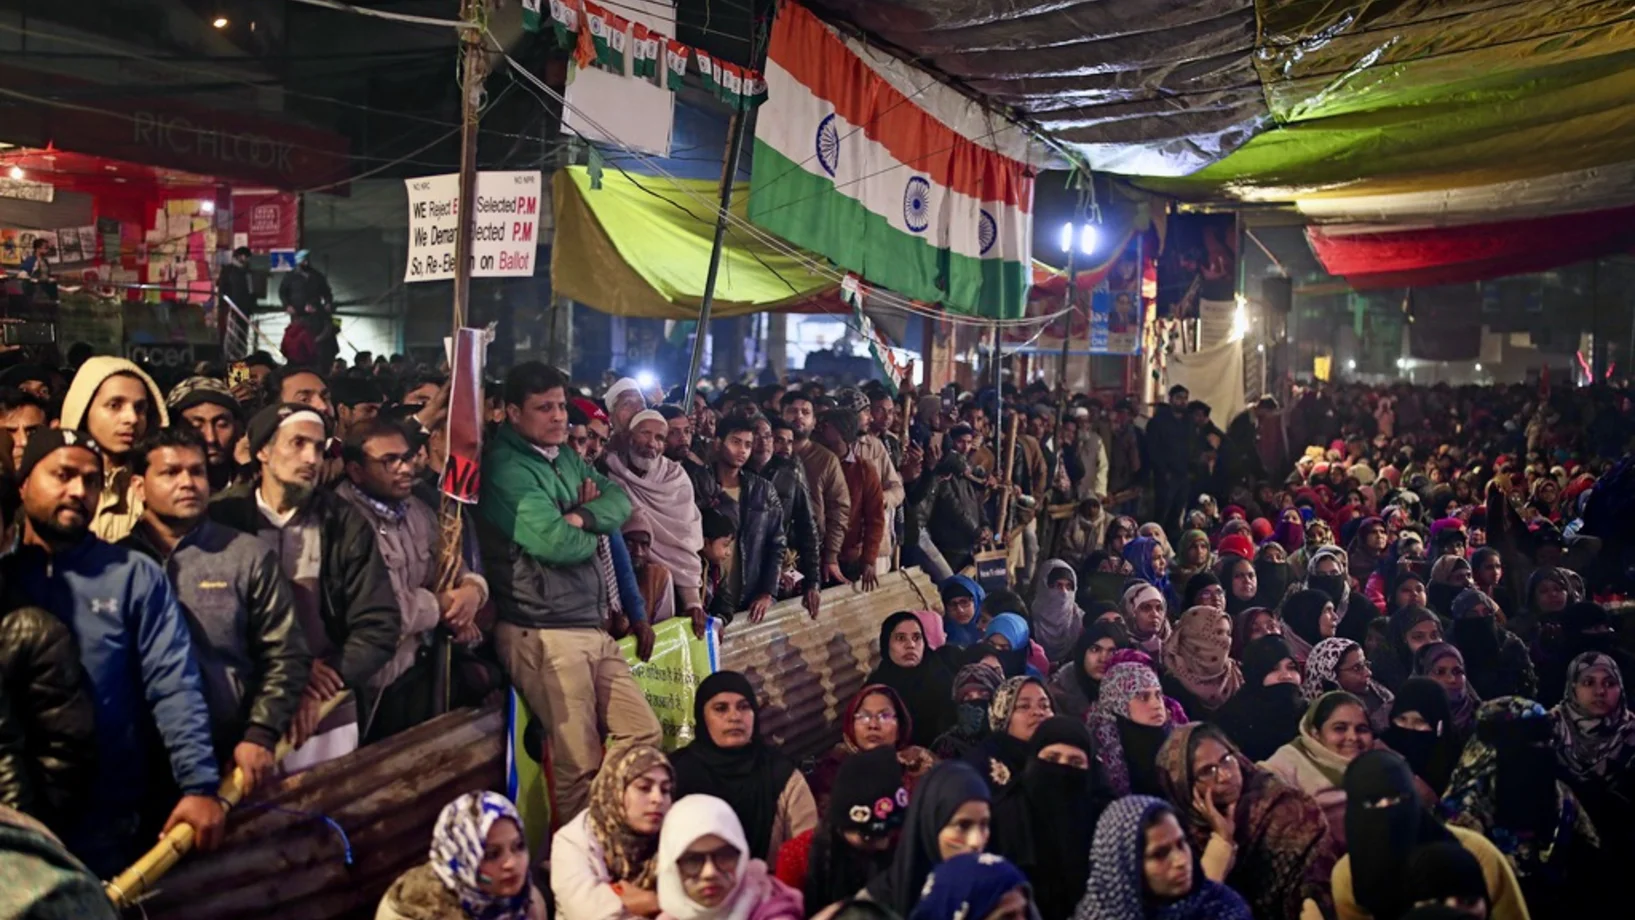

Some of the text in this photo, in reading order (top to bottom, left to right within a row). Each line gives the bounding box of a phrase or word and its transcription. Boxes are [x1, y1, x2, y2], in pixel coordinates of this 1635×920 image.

[413, 202, 427, 219] WE
[429, 200, 451, 221] Reject
[477, 196, 517, 213] Selected
[517, 197, 537, 214] P.M
[414, 225, 458, 247] We Deman
[513, 222, 533, 241] P.M
[480, 255, 494, 270] on
[499, 251, 529, 270] Ballot
